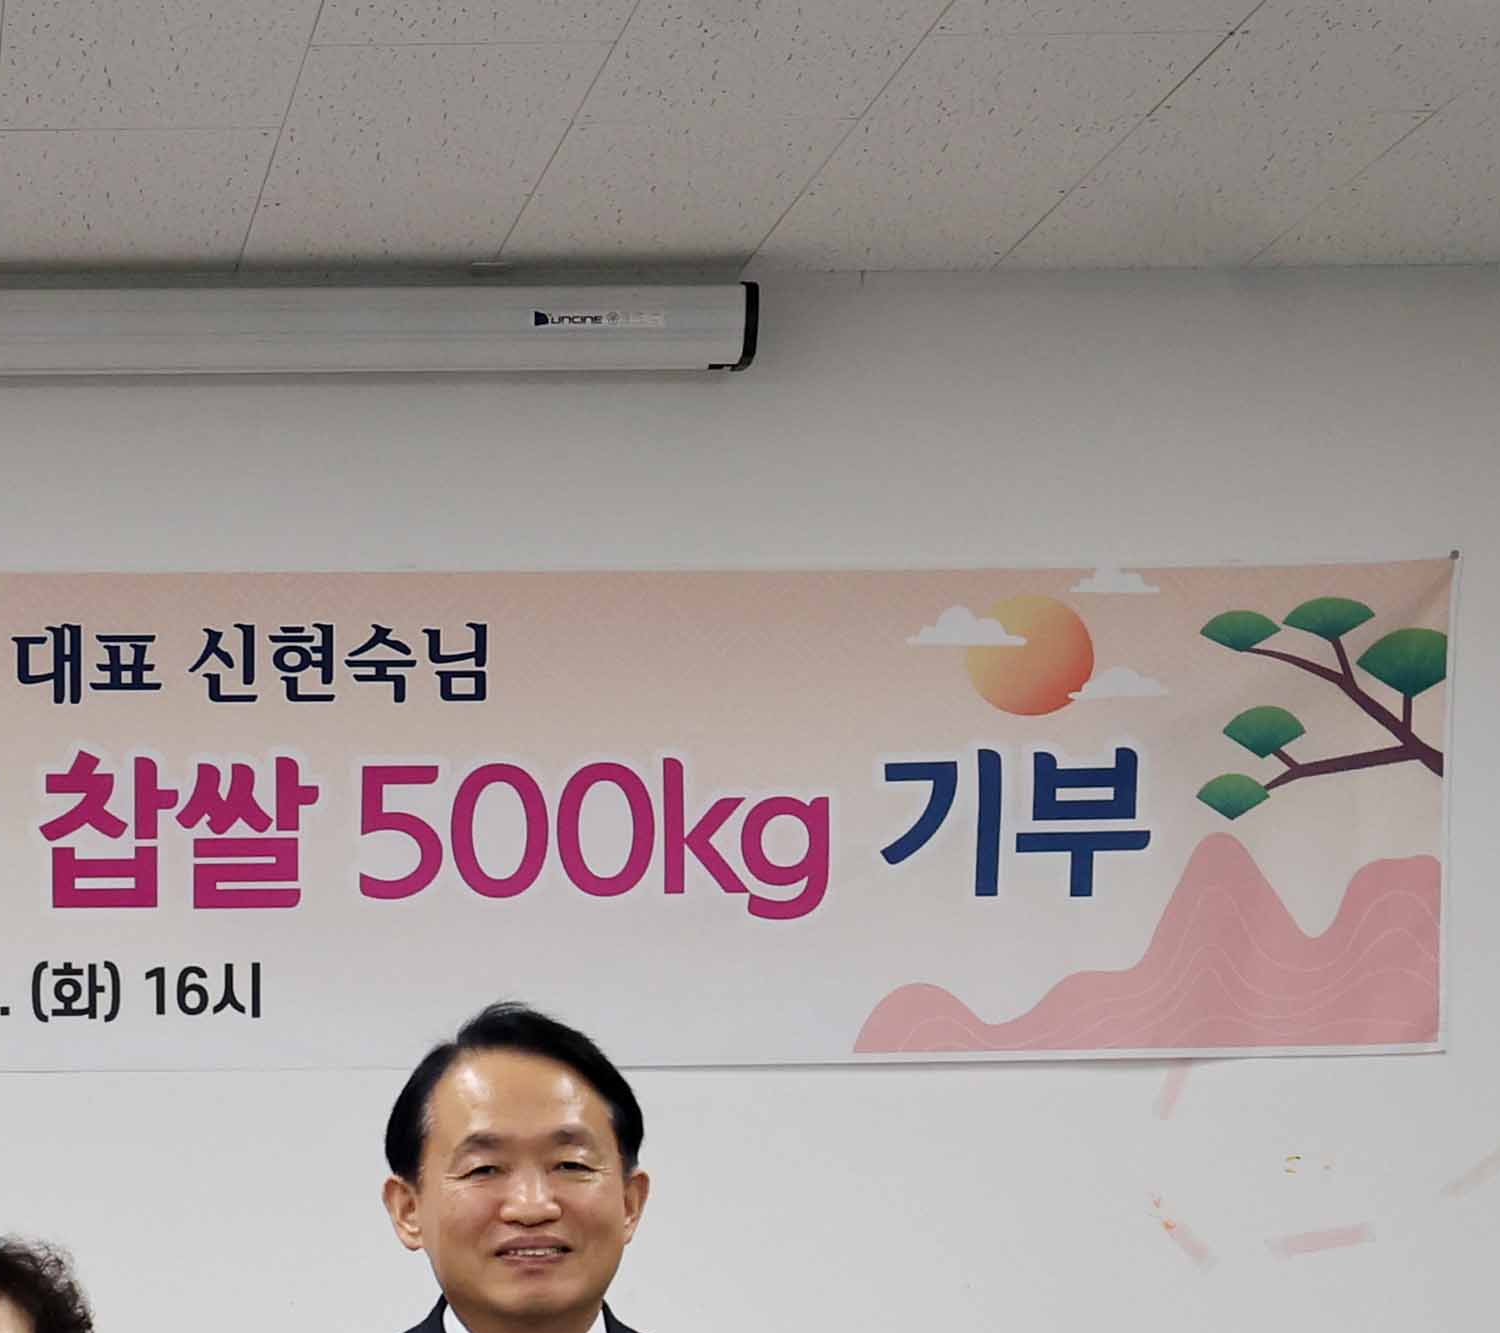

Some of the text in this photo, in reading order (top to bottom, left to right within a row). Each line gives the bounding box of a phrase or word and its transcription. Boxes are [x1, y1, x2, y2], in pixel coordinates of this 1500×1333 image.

[11, 623, 163, 700] 대표
[187, 620, 491, 708] 신현숙님
[37, 747, 319, 912] 찹쌀
[357, 757, 831, 921] 500kg
[880, 747, 1152, 900] 기부
[30, 960, 123, 1024] (화)
[144, 960, 262, 1020] 16시
